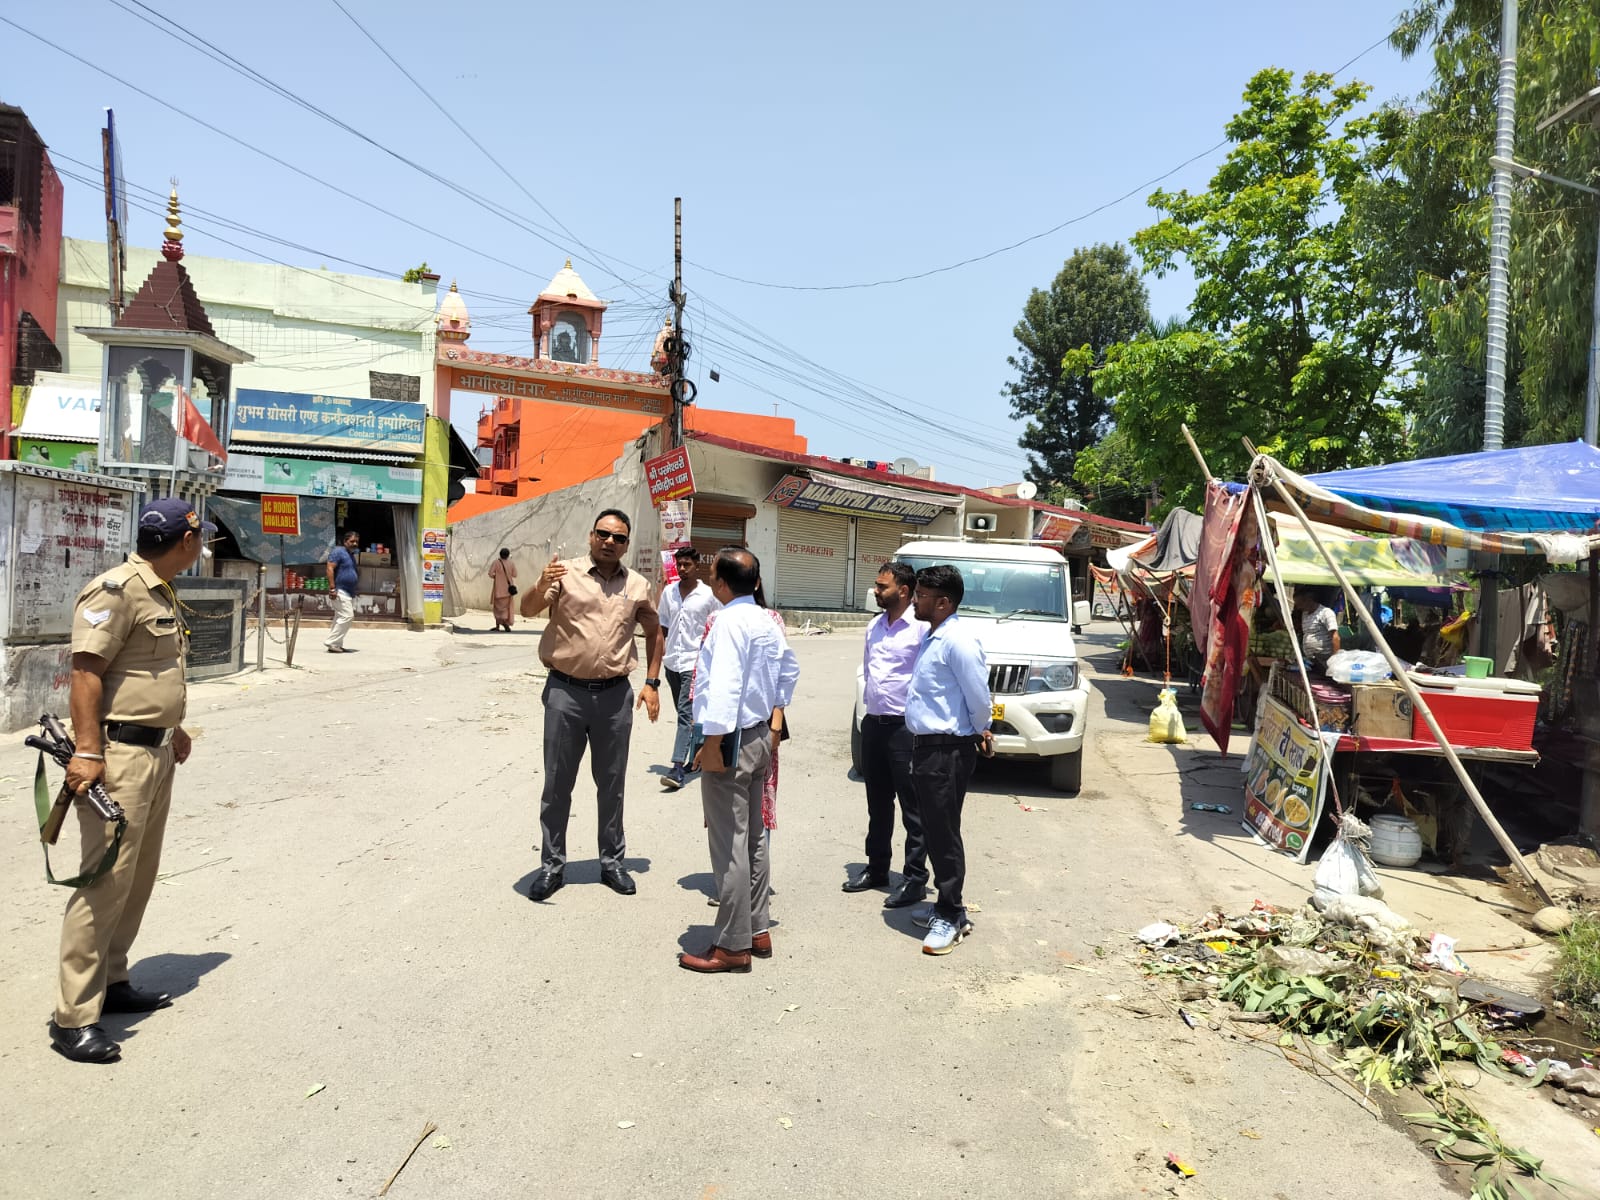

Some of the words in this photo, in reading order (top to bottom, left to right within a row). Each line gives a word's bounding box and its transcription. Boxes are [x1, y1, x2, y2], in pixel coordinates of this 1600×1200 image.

[517, 381, 547, 397] नगर
[236, 405, 265, 424] शुभम
[267, 402, 297, 422] ग्रोसरी
[263, 500, 272, 513] AC
[273, 501, 296, 514] ROOMS
[799, 483, 874, 509] MALHOTRA
[868, 497, 945, 518] ELECTRONICS
[264, 514, 296, 528] AVAILABLE
[786, 543, 798, 553] NO
[800, 545, 834, 558] PARKING
